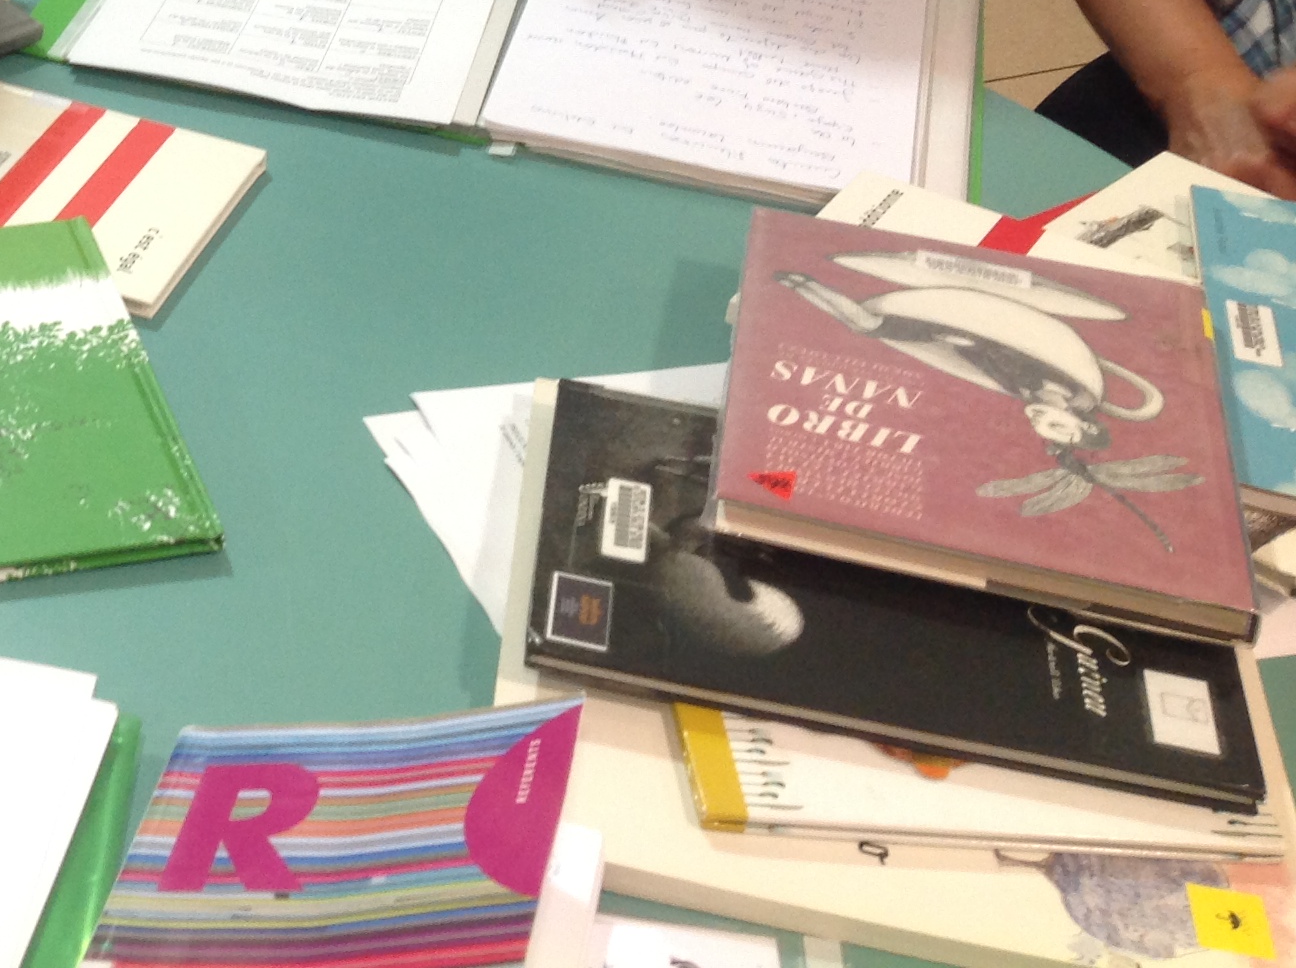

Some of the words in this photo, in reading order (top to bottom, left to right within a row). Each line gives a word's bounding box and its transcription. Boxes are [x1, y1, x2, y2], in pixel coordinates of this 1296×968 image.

[770, 359, 924, 409] NANAS
[818, 393, 873, 419] DE
[767, 403, 923, 454] LIBRO
[515, 738, 542, 804] REFERENTS
[158, 763, 321, 893] R
